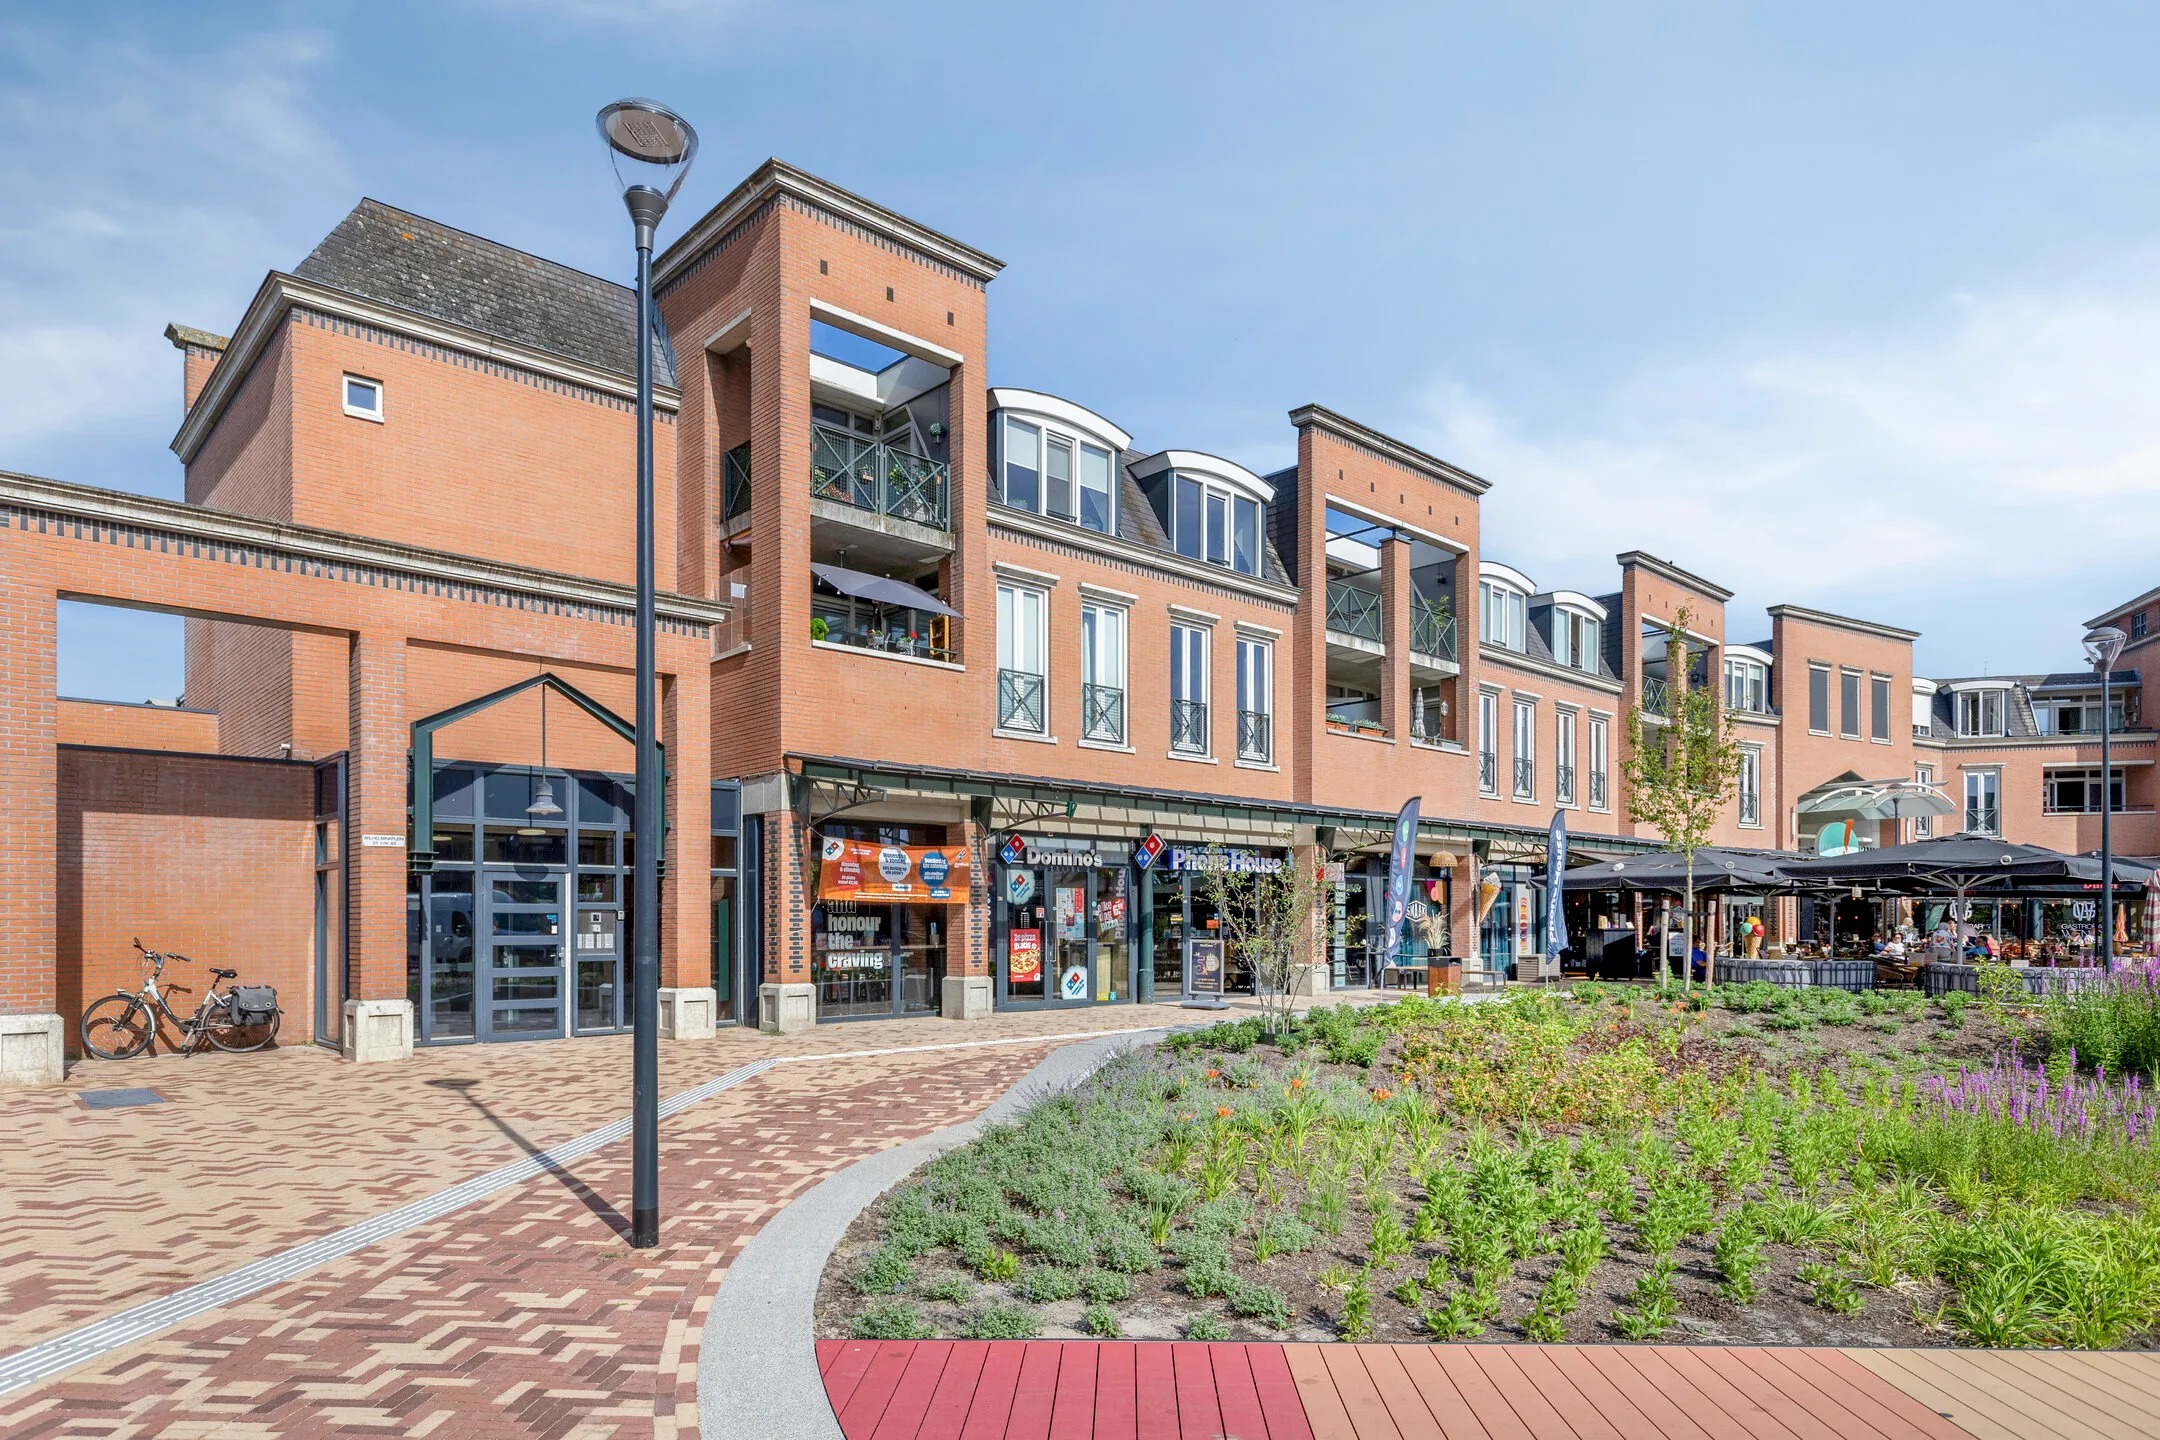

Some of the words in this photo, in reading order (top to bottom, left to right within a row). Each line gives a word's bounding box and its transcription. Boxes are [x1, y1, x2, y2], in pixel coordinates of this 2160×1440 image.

[1026, 846, 1103, 867] Domino's
[1172, 848, 1229, 872] Phone
[1230, 850, 1282, 874] House
[828, 914, 881, 931] honour
[828, 932, 853, 949] the
[828, 950, 883, 969] craving
